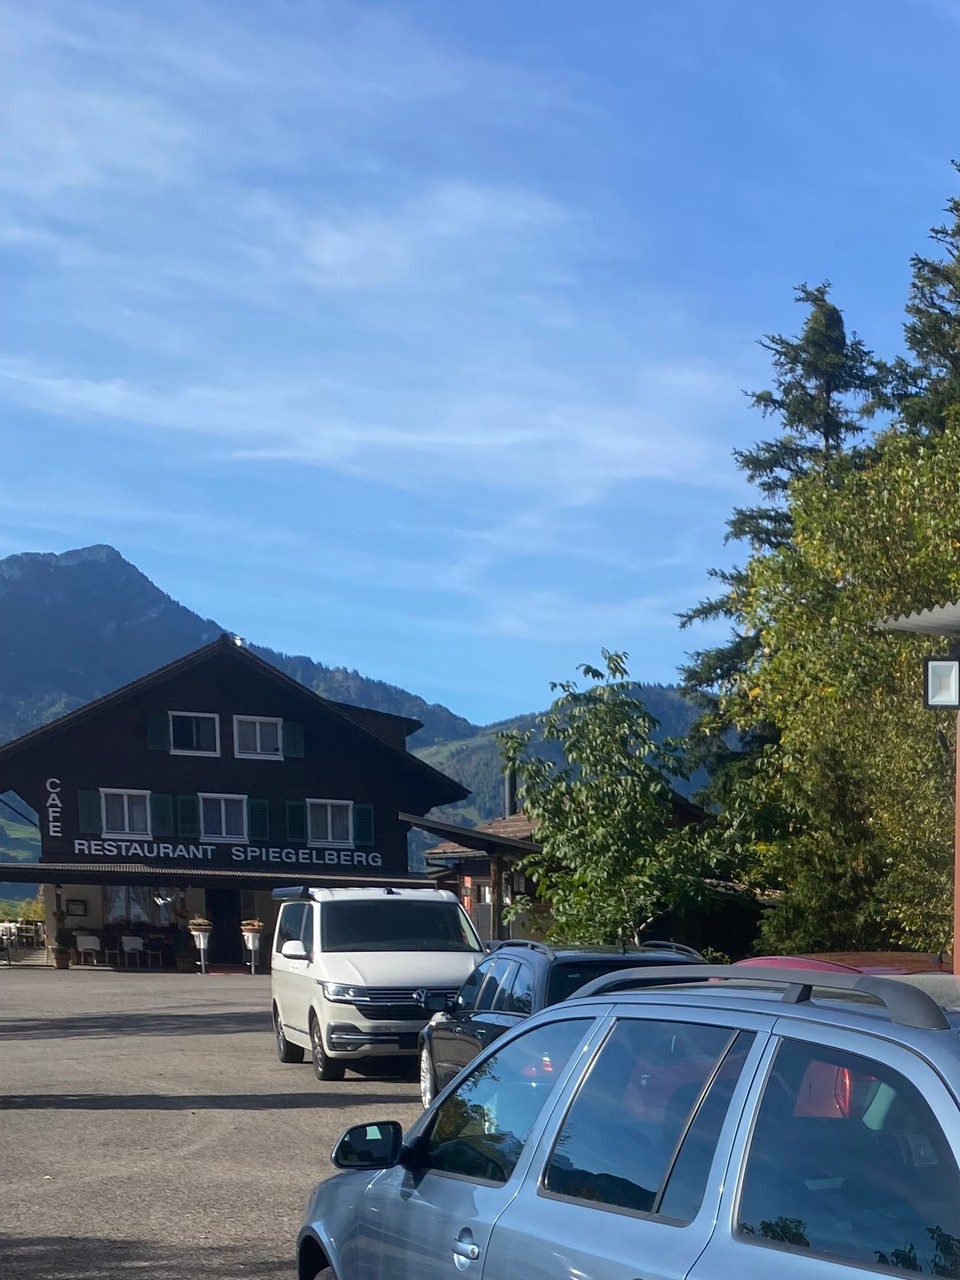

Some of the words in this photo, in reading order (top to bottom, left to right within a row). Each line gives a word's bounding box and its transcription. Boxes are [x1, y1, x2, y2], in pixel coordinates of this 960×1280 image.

[45, 778, 62, 837] CAFE
[74, 839, 216, 860] RESTAURANT
[231, 846, 382, 867] SPIEGELBERG
